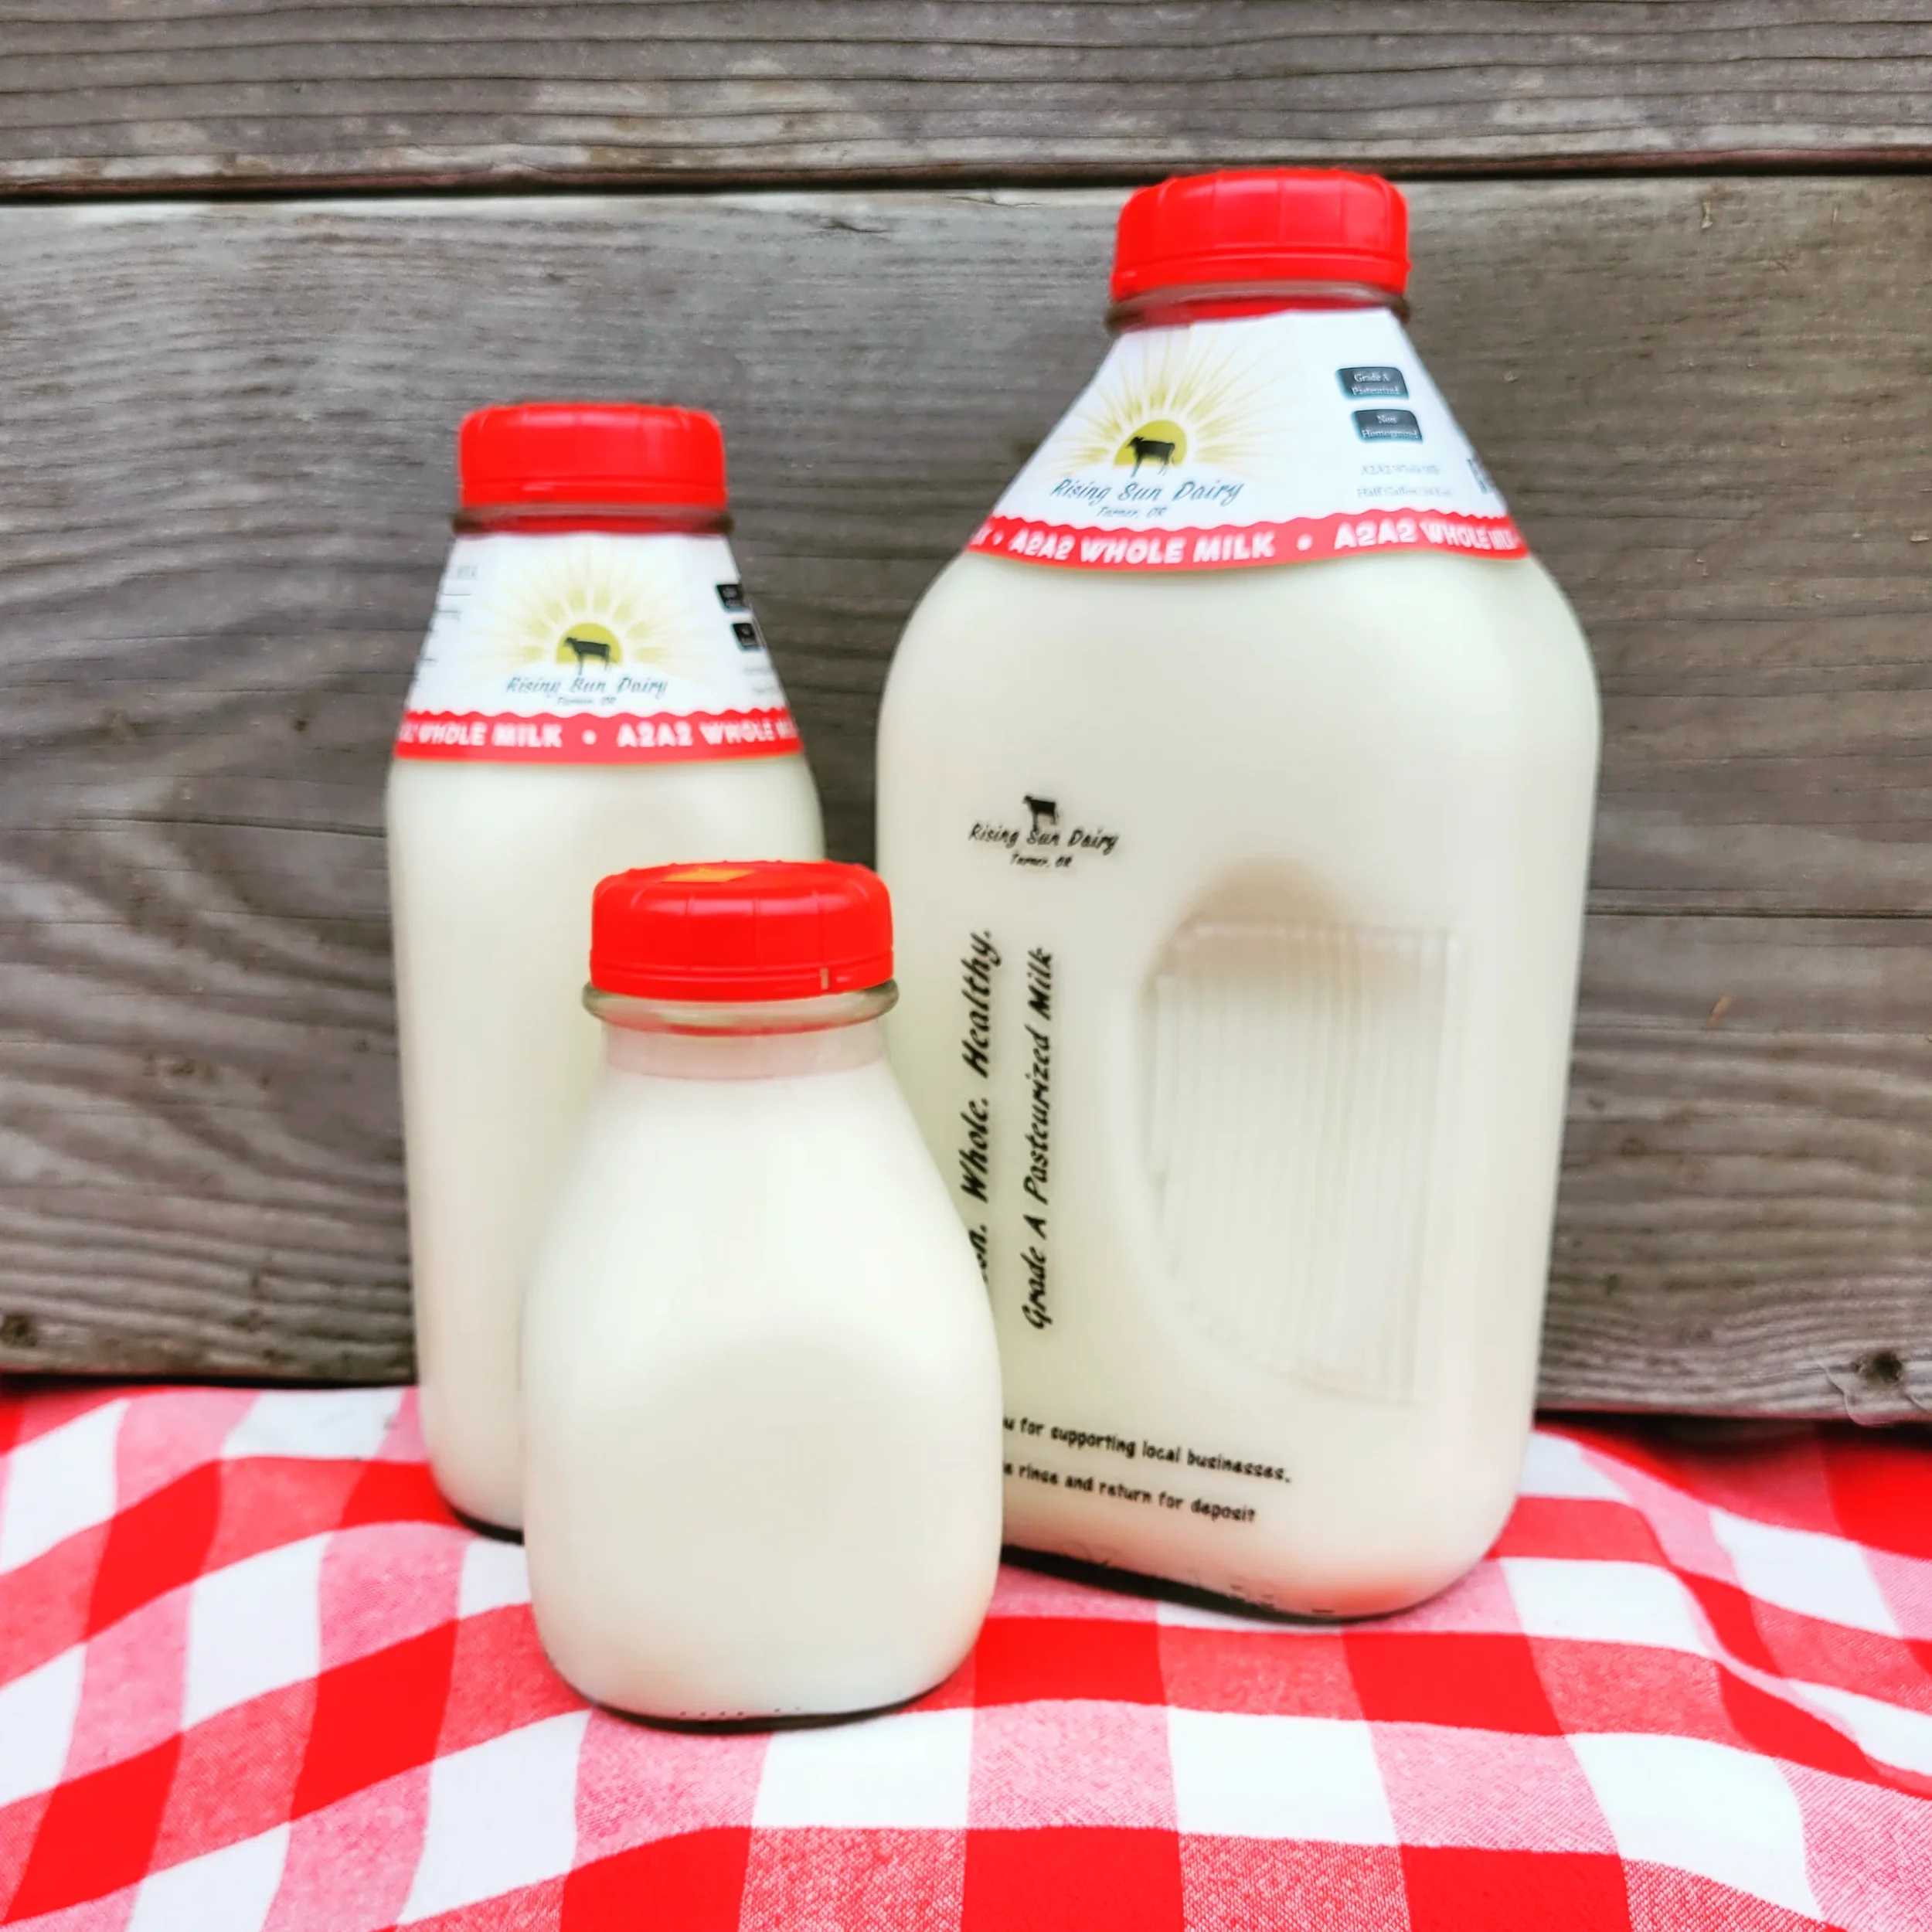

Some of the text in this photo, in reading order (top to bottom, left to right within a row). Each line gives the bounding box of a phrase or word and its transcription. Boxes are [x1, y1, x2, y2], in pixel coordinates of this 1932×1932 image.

[1049, 478, 1246, 507] Rising Sun Dairy
[1008, 527, 1076, 561] A2A2
[1081, 536, 1185, 564] WHOLE
[1192, 529, 1275, 563] MILK
[1333, 519, 1417, 551] A2A2
[1419, 518, 1492, 551] WHOLE
[417, 721, 488, 747] WHOLE
[491, 722, 563, 748] MILK
[616, 719, 693, 748] A2A2
[698, 718, 775, 745] WHOLE
[968, 821, 1120, 855] Rising Sun Dairy
[960, 929, 1002, 1080] Healthy.
[958, 1097, 990, 1204] Whole.
[1019, 944, 1053, 1330] Grade A Pasteurized Milk
[1020, 1417, 1045, 1437] for
[1050, 1425, 1137, 1460] supporting
[1141, 1438, 1182, 1463] local
[1186, 1447, 1291, 1484] businesses.
[1064, 1475, 1094, 1493] and
[1098, 1481, 1152, 1504] return
[1158, 1491, 1184, 1510] for
